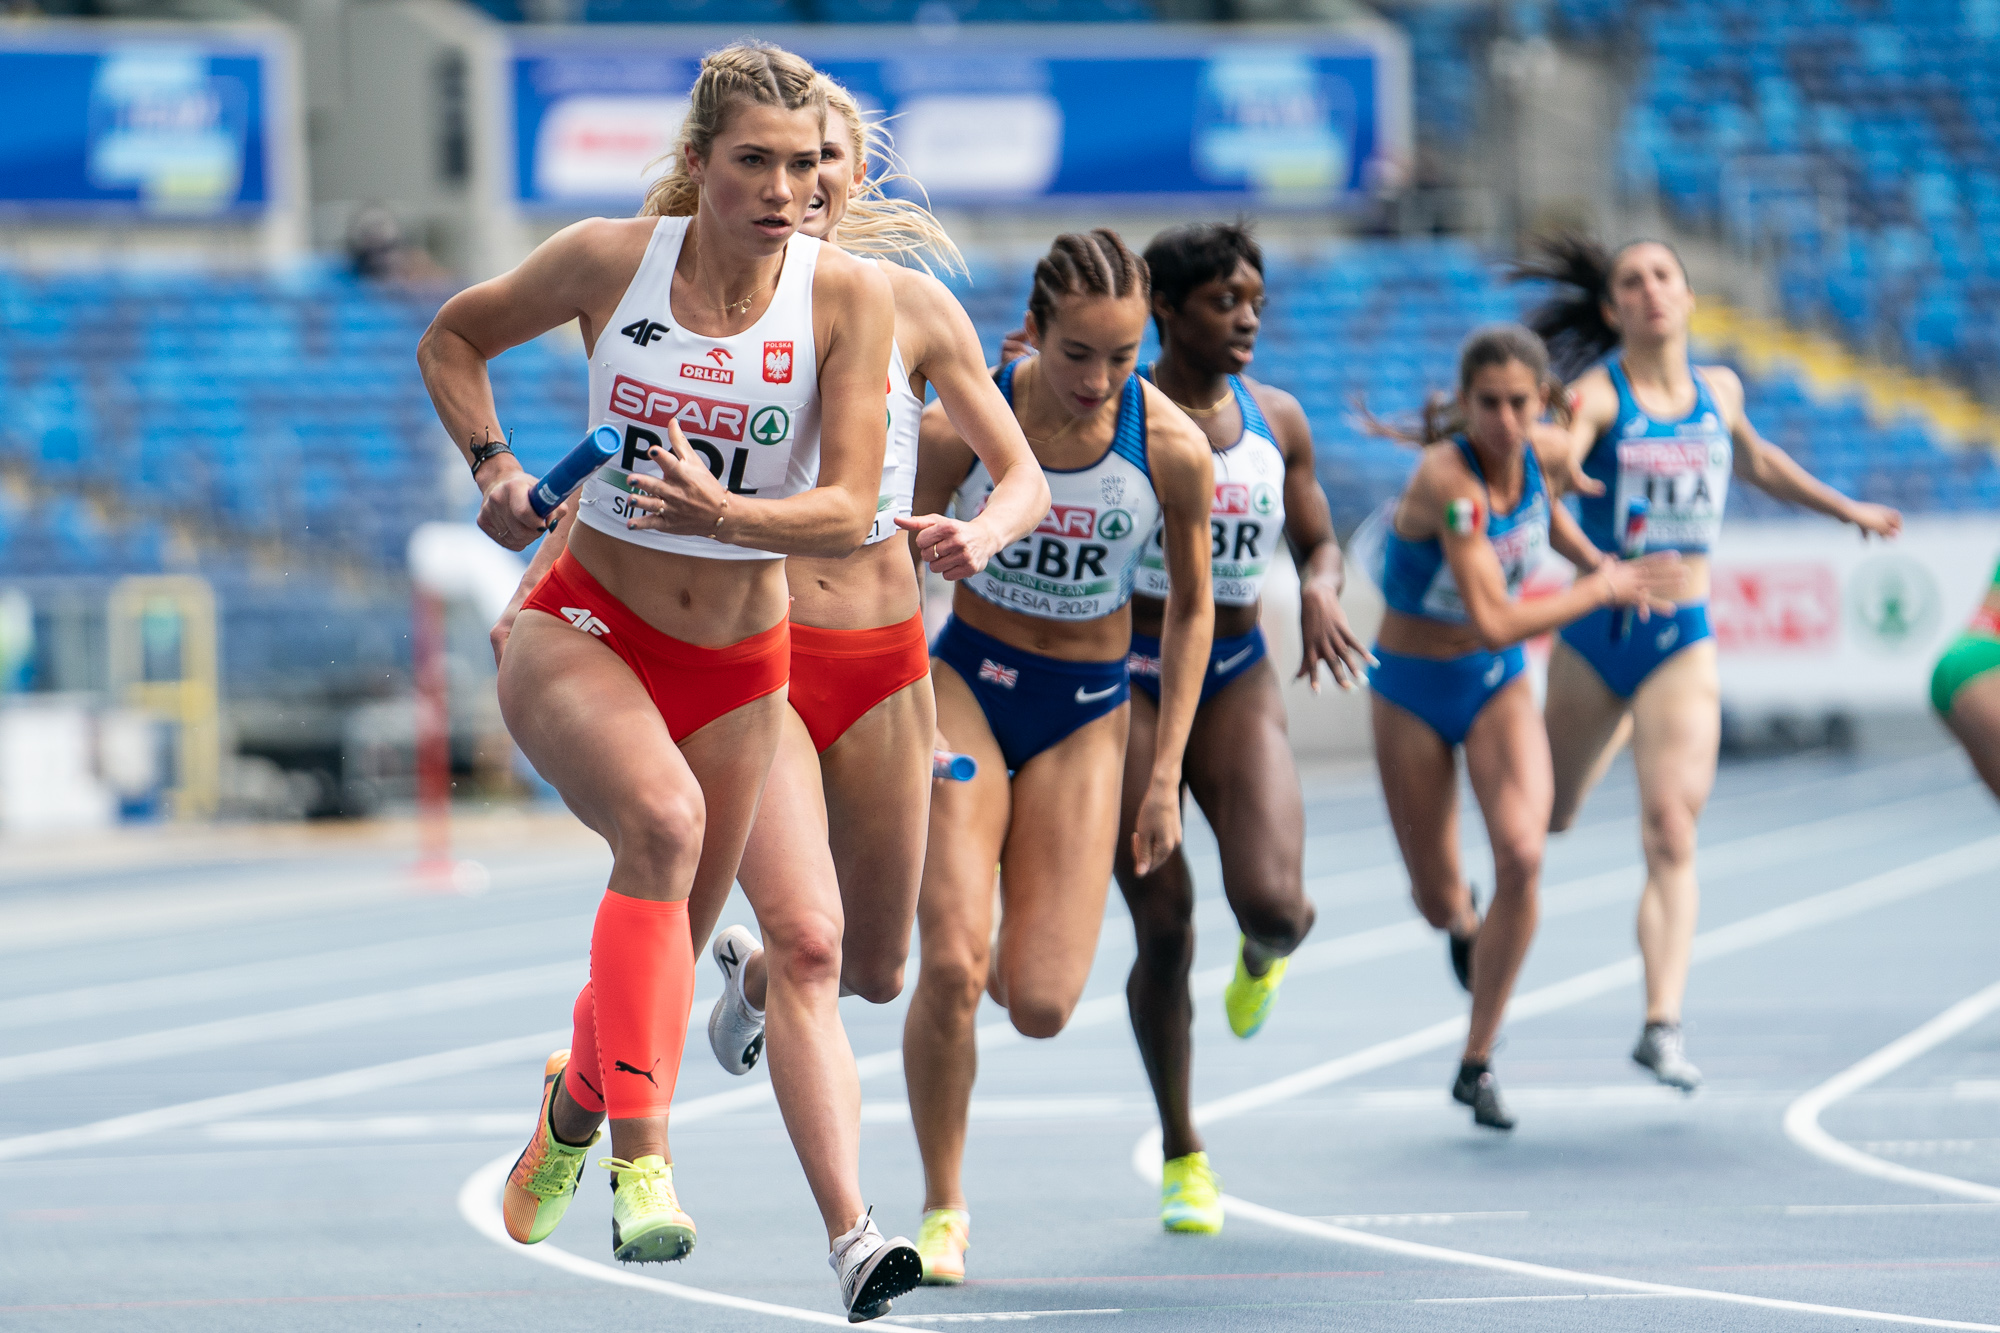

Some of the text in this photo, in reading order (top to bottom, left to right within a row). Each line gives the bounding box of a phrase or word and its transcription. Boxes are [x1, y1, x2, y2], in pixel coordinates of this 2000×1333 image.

[621, 317, 671, 348] 4F
[683, 365, 732, 383] ORLEN
[614, 381, 744, 437] SPAR
[986, 578, 1100, 614] SILESIA 2021
[560, 606, 611, 636] 4F
